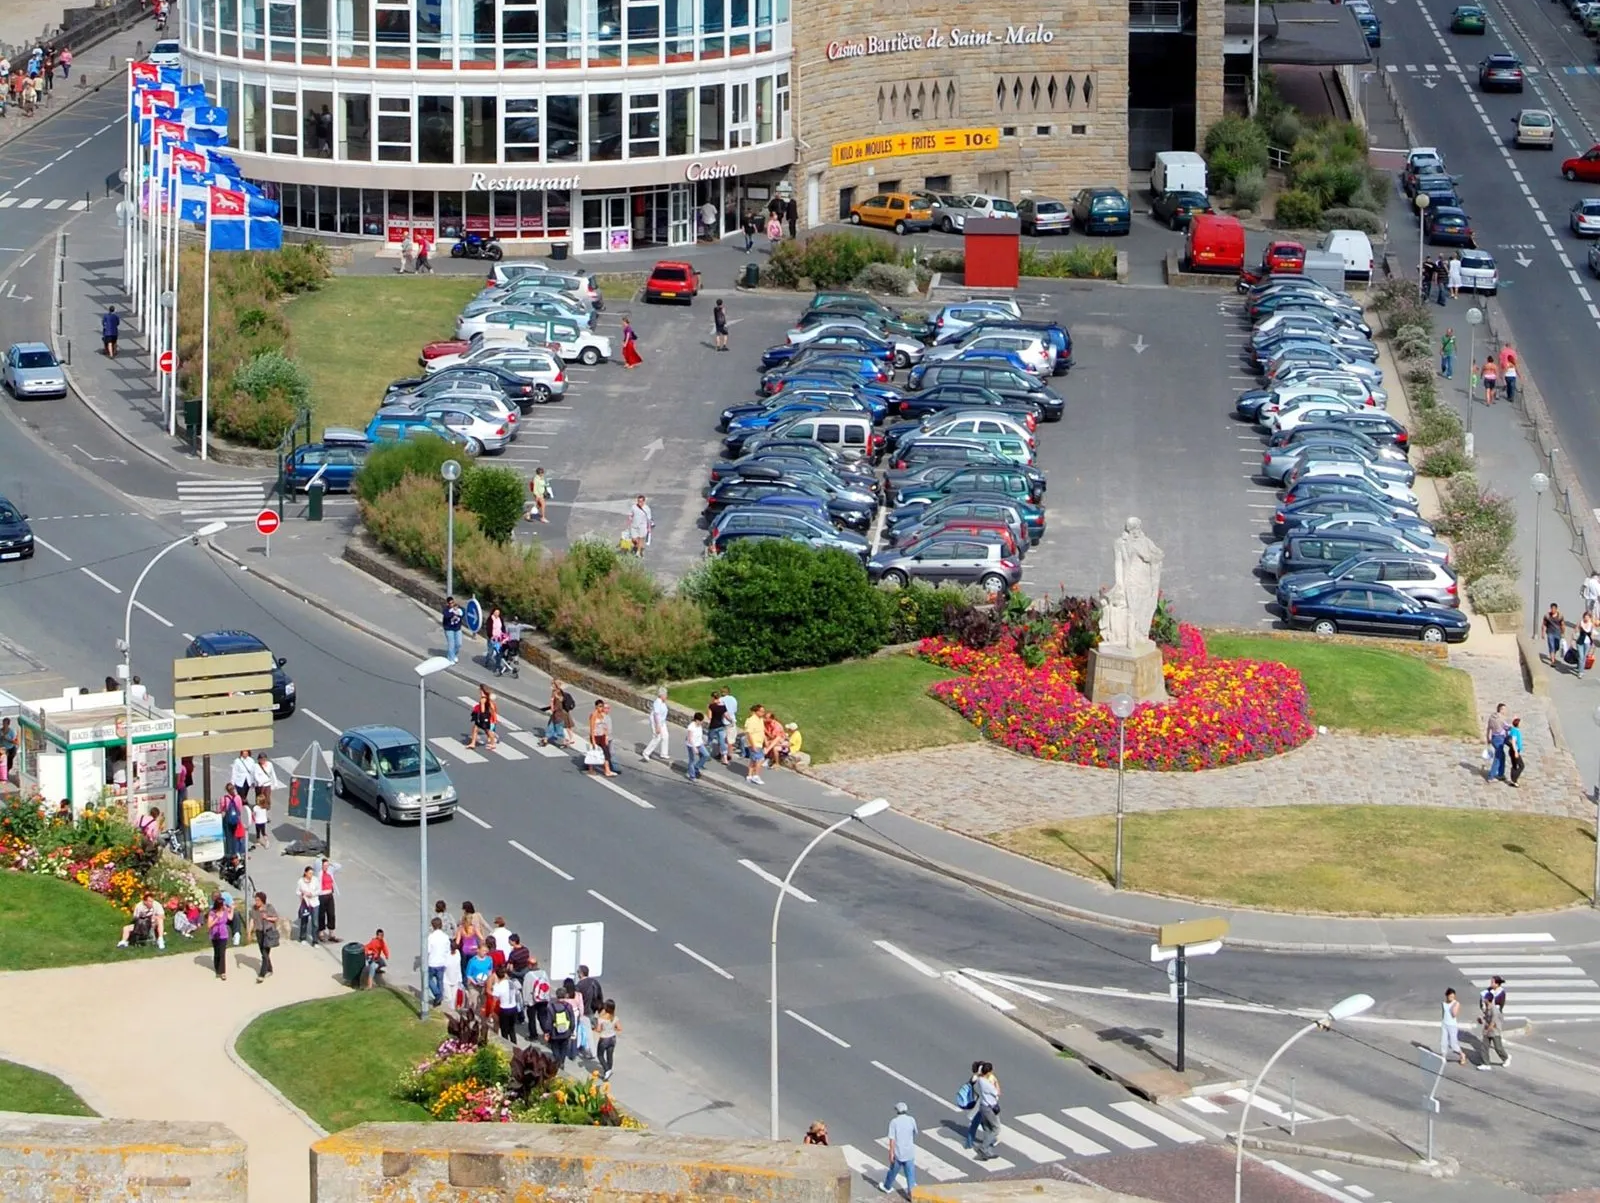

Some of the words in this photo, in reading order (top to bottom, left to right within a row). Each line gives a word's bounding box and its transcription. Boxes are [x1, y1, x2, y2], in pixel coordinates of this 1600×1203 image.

[827, 41, 865, 61] Casino
[867, 32, 922, 55] Barrière
[926, 28, 944, 49] de
[840, 146, 854, 161] KILO
[855, 144, 863, 158] de
[865, 139, 893, 156] MOULES
[911, 135, 936, 150] FRITES
[471, 171, 581, 191] Restaurant
[685, 161, 738, 183] Casino
